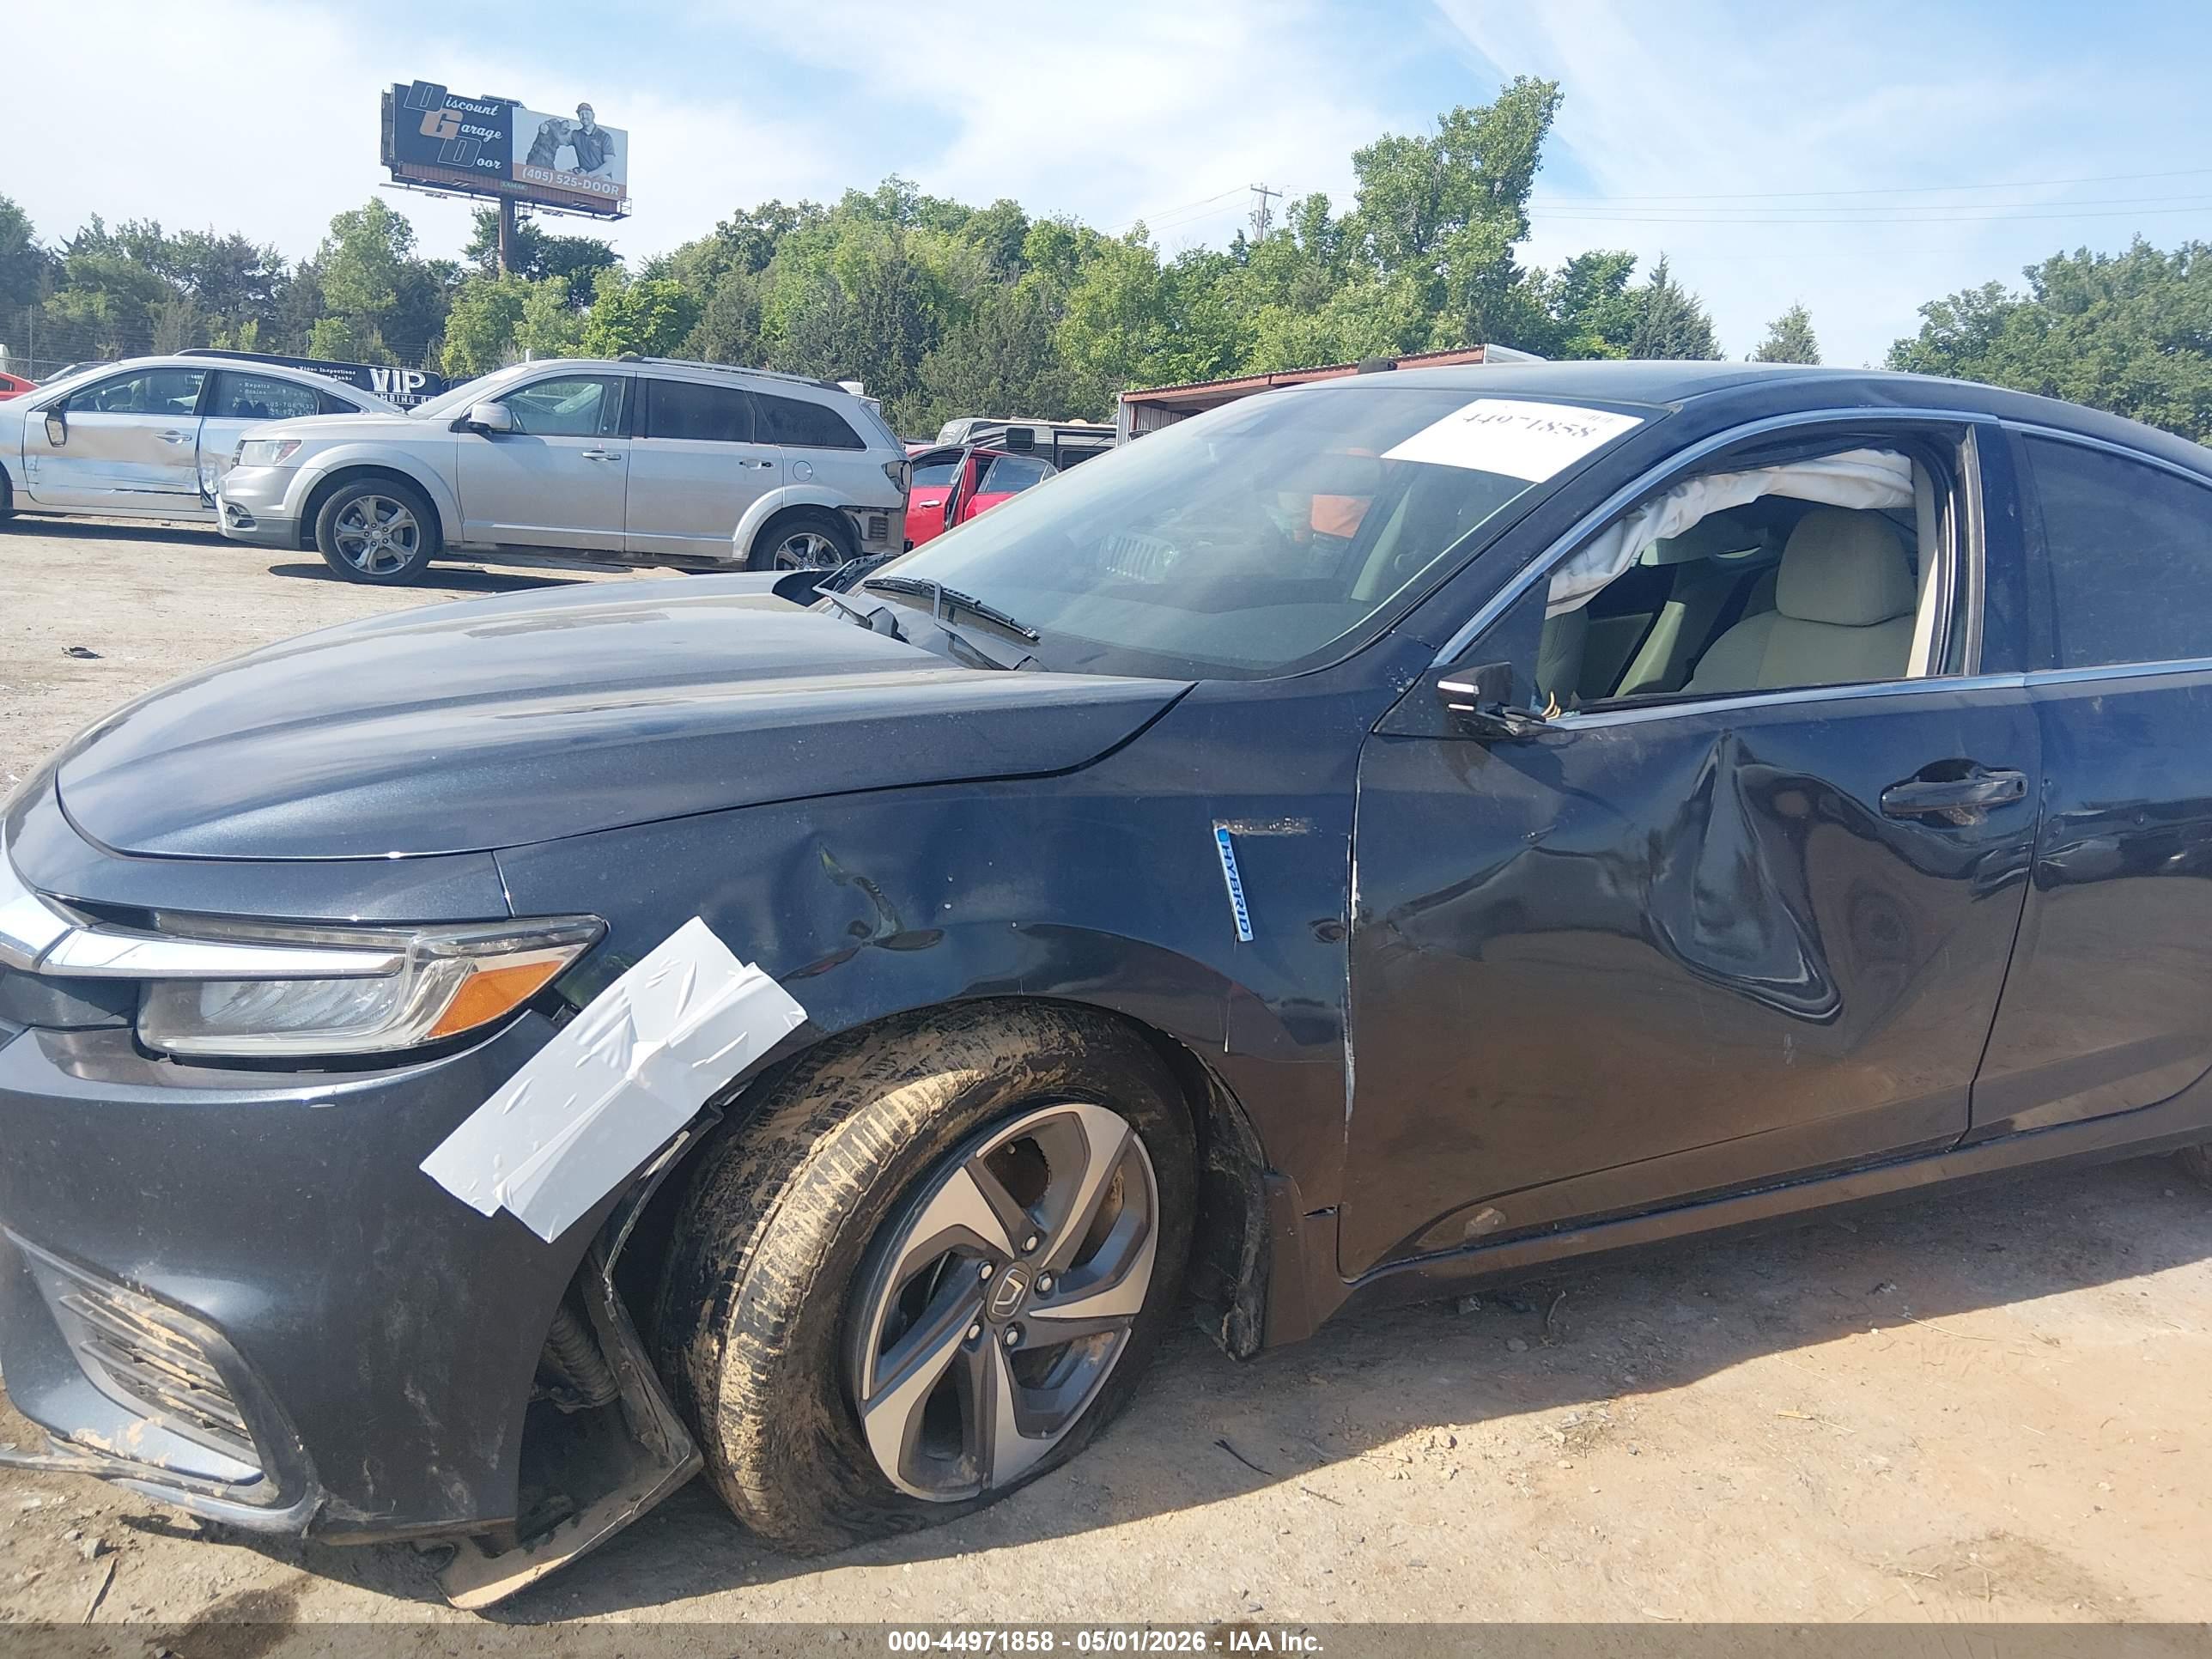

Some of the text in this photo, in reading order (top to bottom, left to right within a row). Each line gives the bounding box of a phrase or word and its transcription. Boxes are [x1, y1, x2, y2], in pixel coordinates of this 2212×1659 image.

[404, 79, 498, 117] Discount
[419, 109, 502, 142] Garage
[437, 135, 502, 170] Door
[522, 167, 619, 197] (405) 525-DOOR
[369, 368, 426, 393] VIP
[1222, 844, 1249, 934] HYBRID
